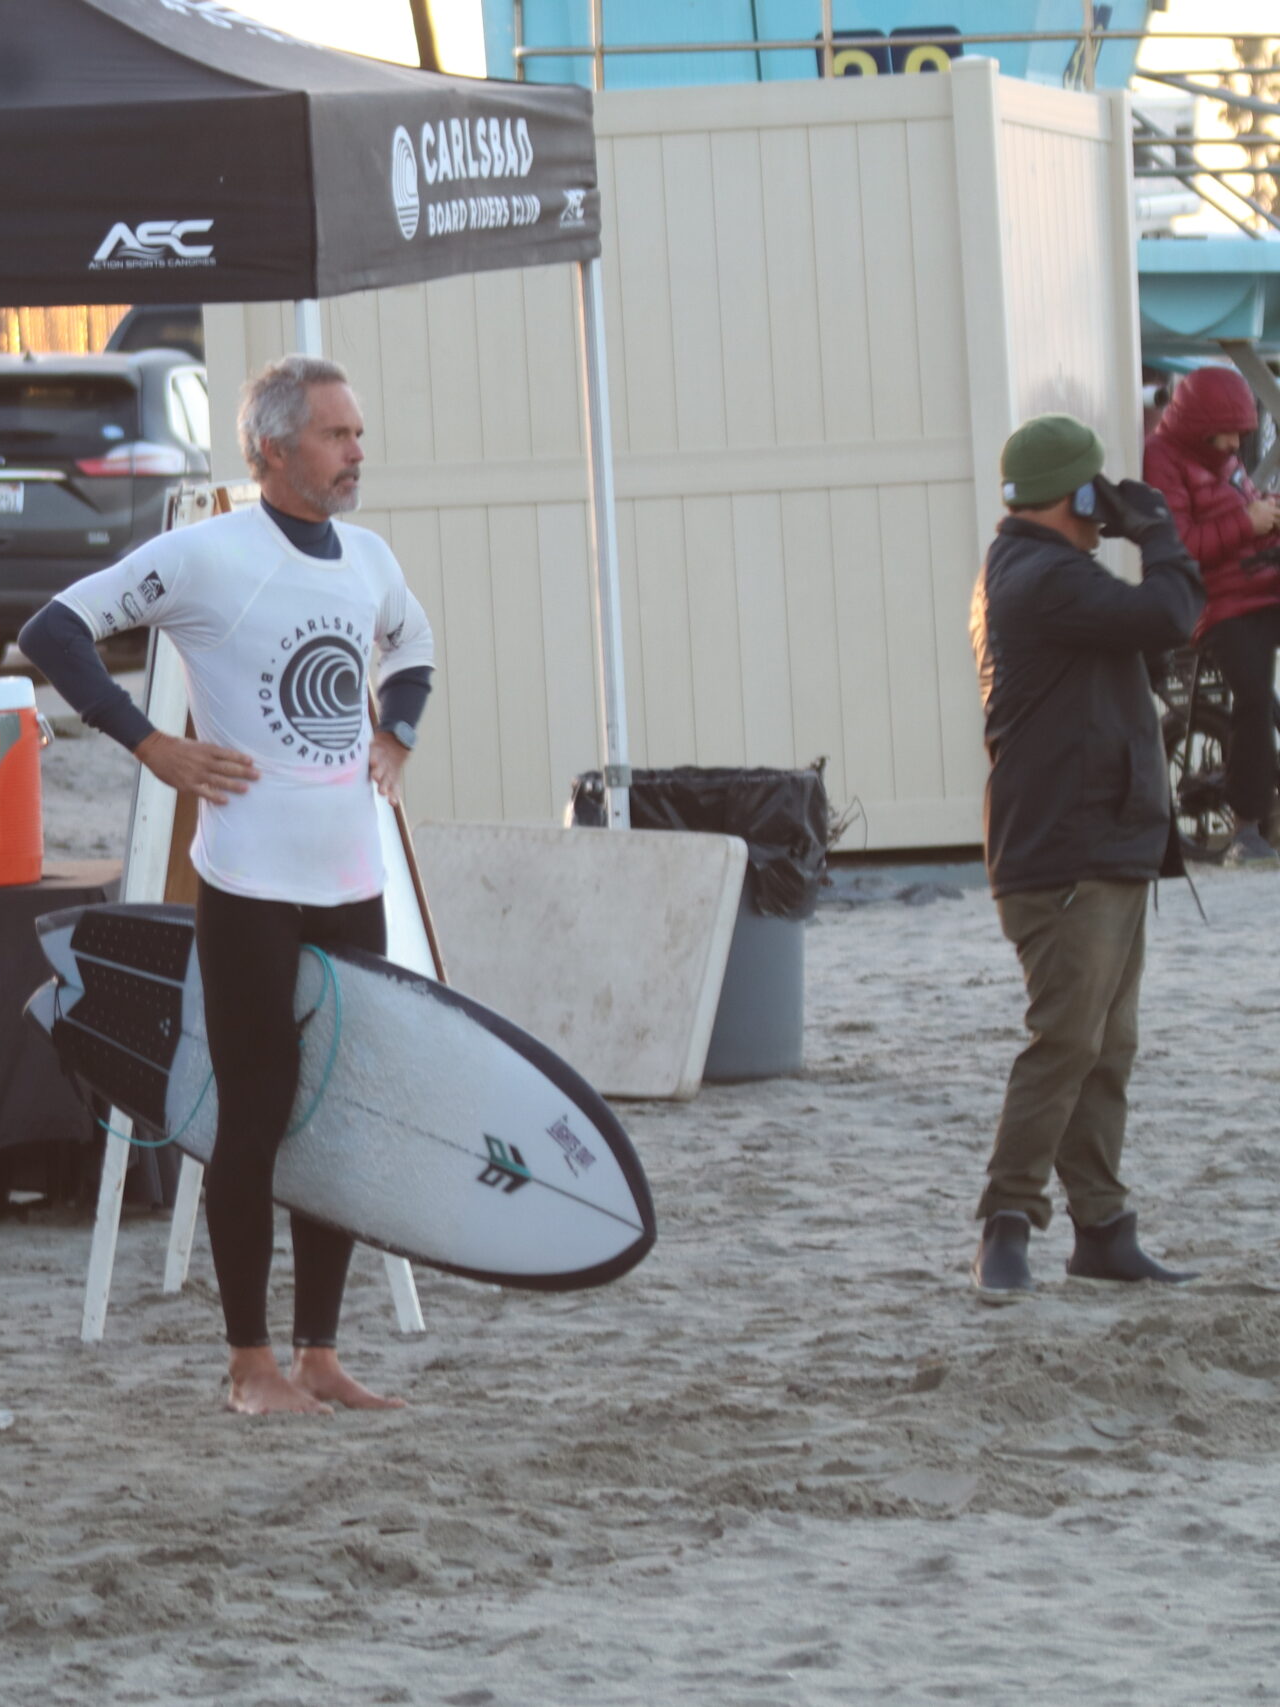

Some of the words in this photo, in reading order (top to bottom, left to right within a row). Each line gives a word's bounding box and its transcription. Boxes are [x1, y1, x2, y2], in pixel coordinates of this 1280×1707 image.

[421, 116, 534, 185] CARLSBAD
[428, 199, 468, 237] BOARD
[469, 195, 510, 230] RIDERS
[511, 194, 541, 226] CLUB
[93, 219, 215, 260] ASC
